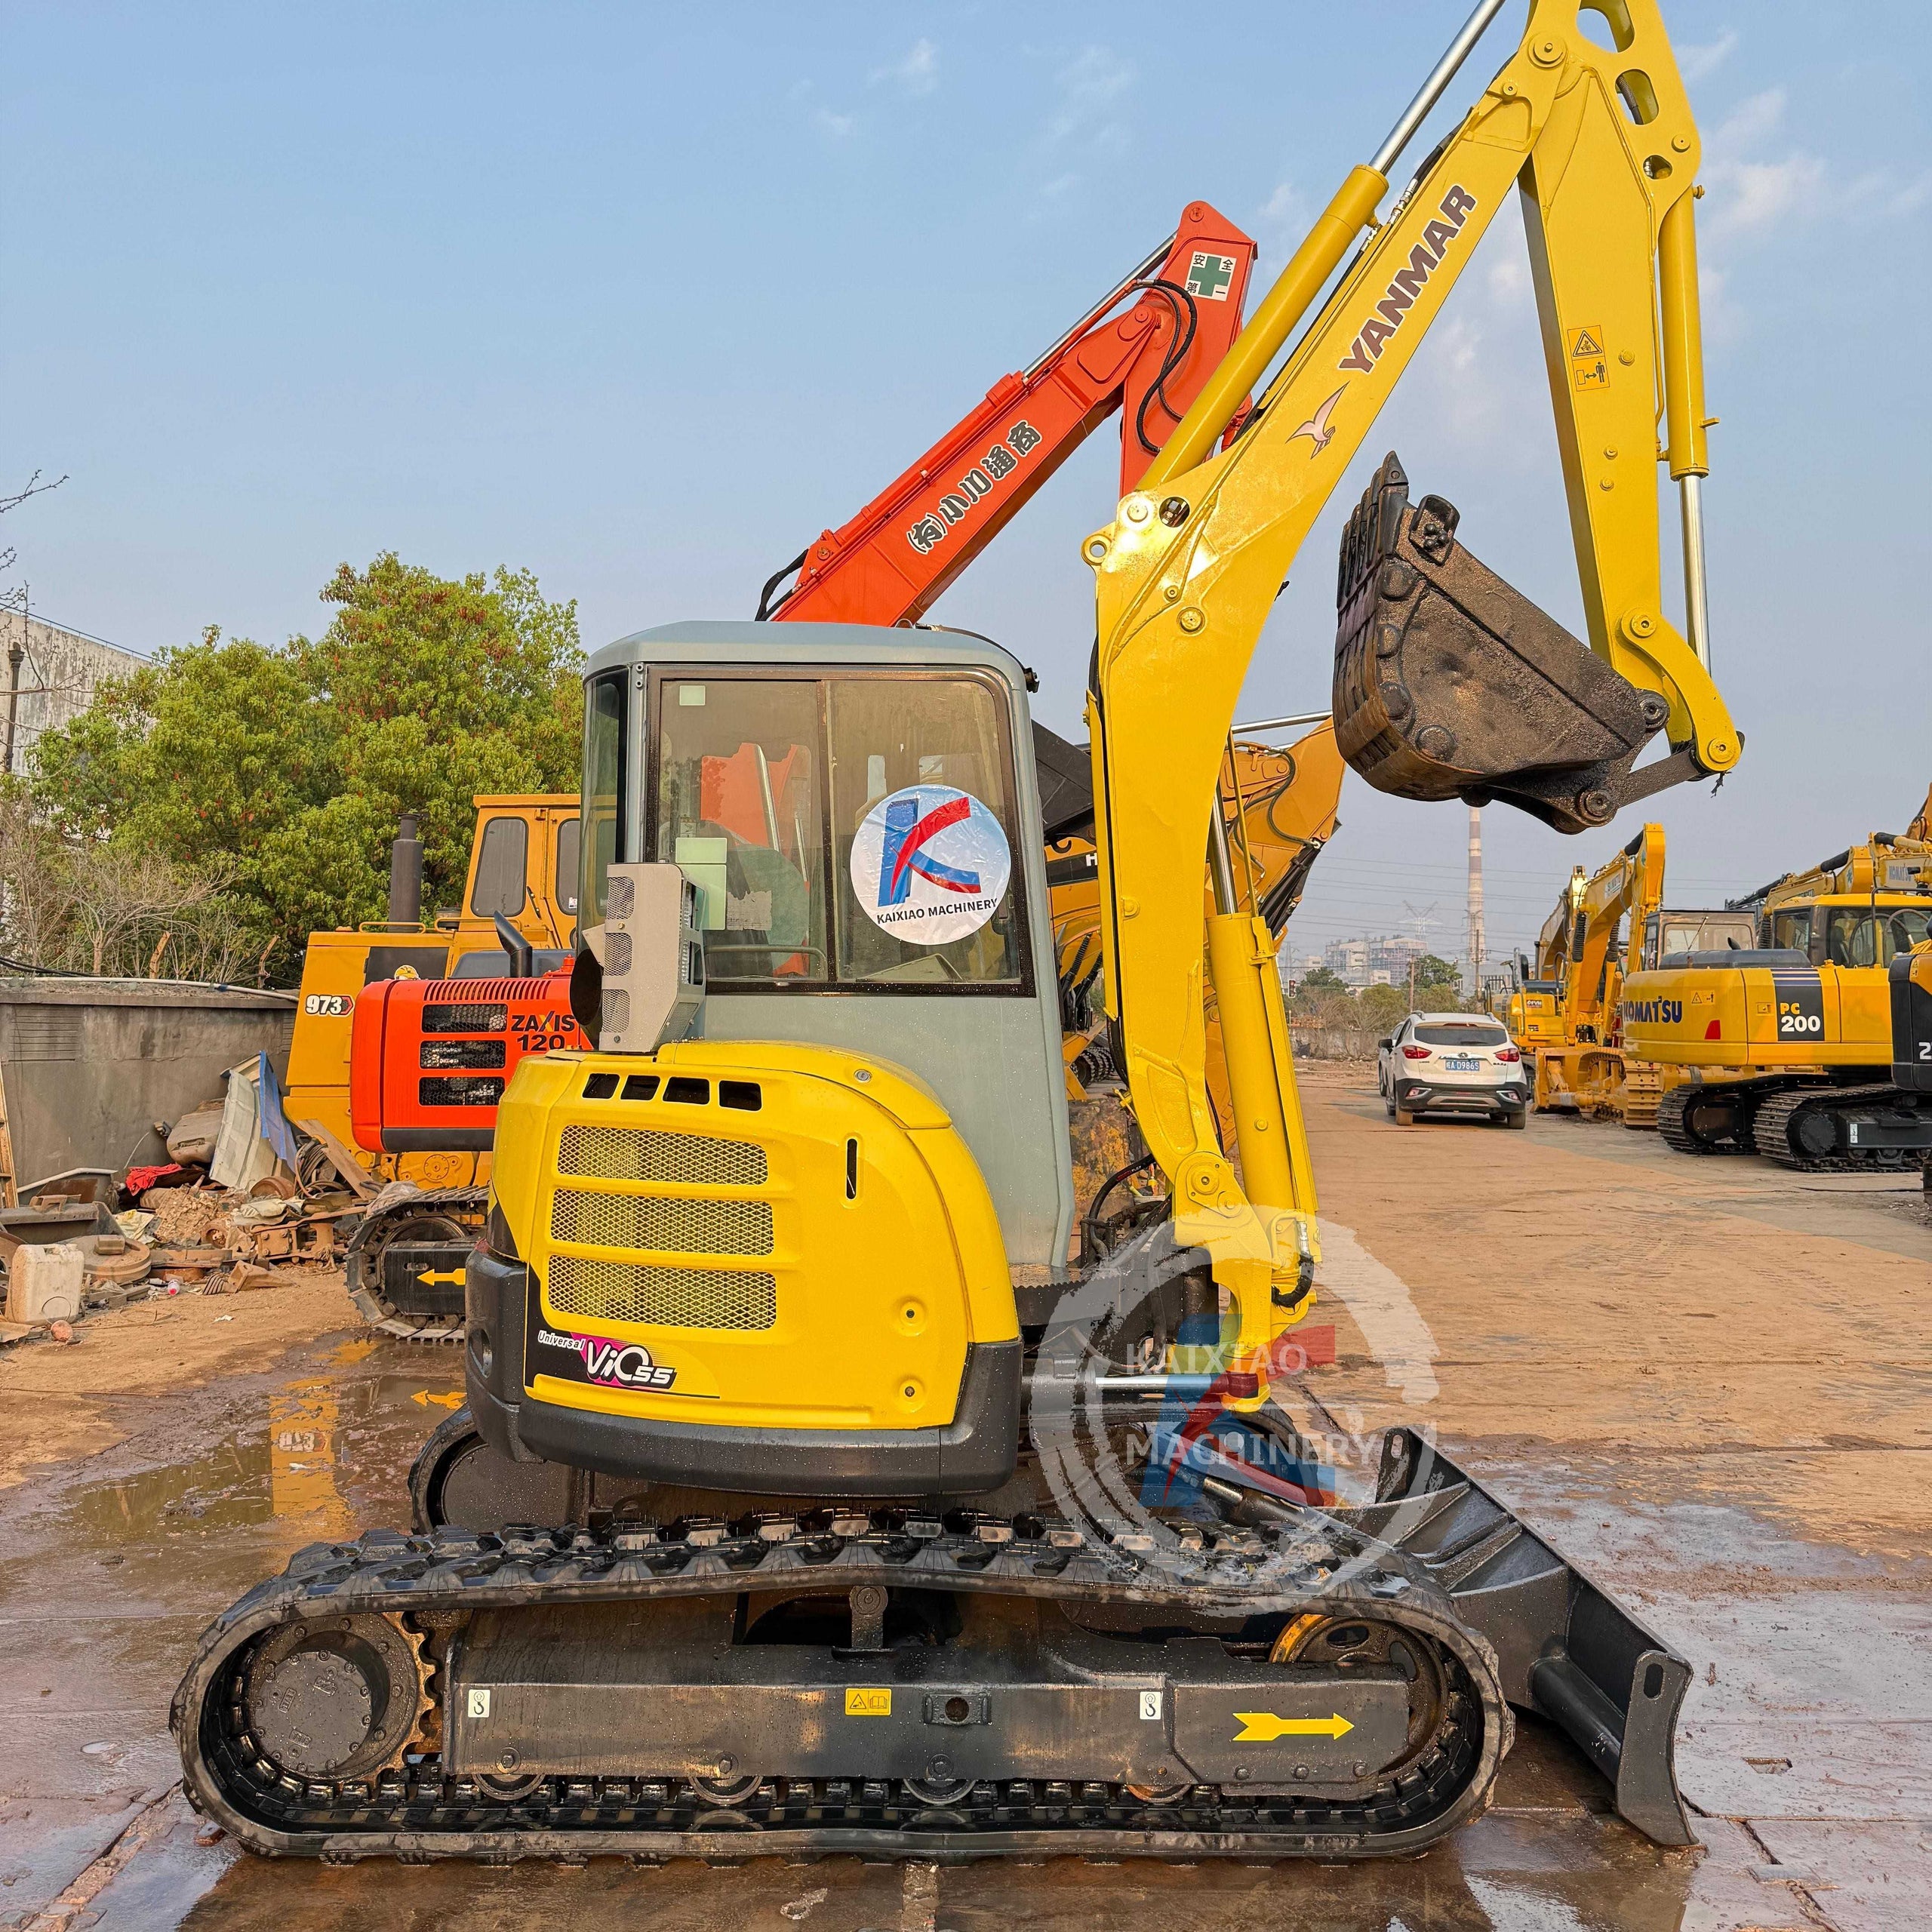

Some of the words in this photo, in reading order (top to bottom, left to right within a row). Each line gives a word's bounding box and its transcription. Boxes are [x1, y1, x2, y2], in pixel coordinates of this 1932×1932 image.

[1339, 183, 1477, 374] YANMAR
[877, 908, 924, 924] KAIXIAO
[928, 898, 998, 918] MACHINERY
[306, 994, 343, 1014] 973
[1623, 995, 1682, 1023] KOMATSU
[1780, 1002, 1800, 1015] PC
[511, 1010, 575, 1032] ZAXIS
[1781, 1015, 1820, 1032] 200
[517, 1034, 565, 1051] 120
[1918, 1041, 1932, 1060] 2
[538, 1330, 586, 1351] Universal
